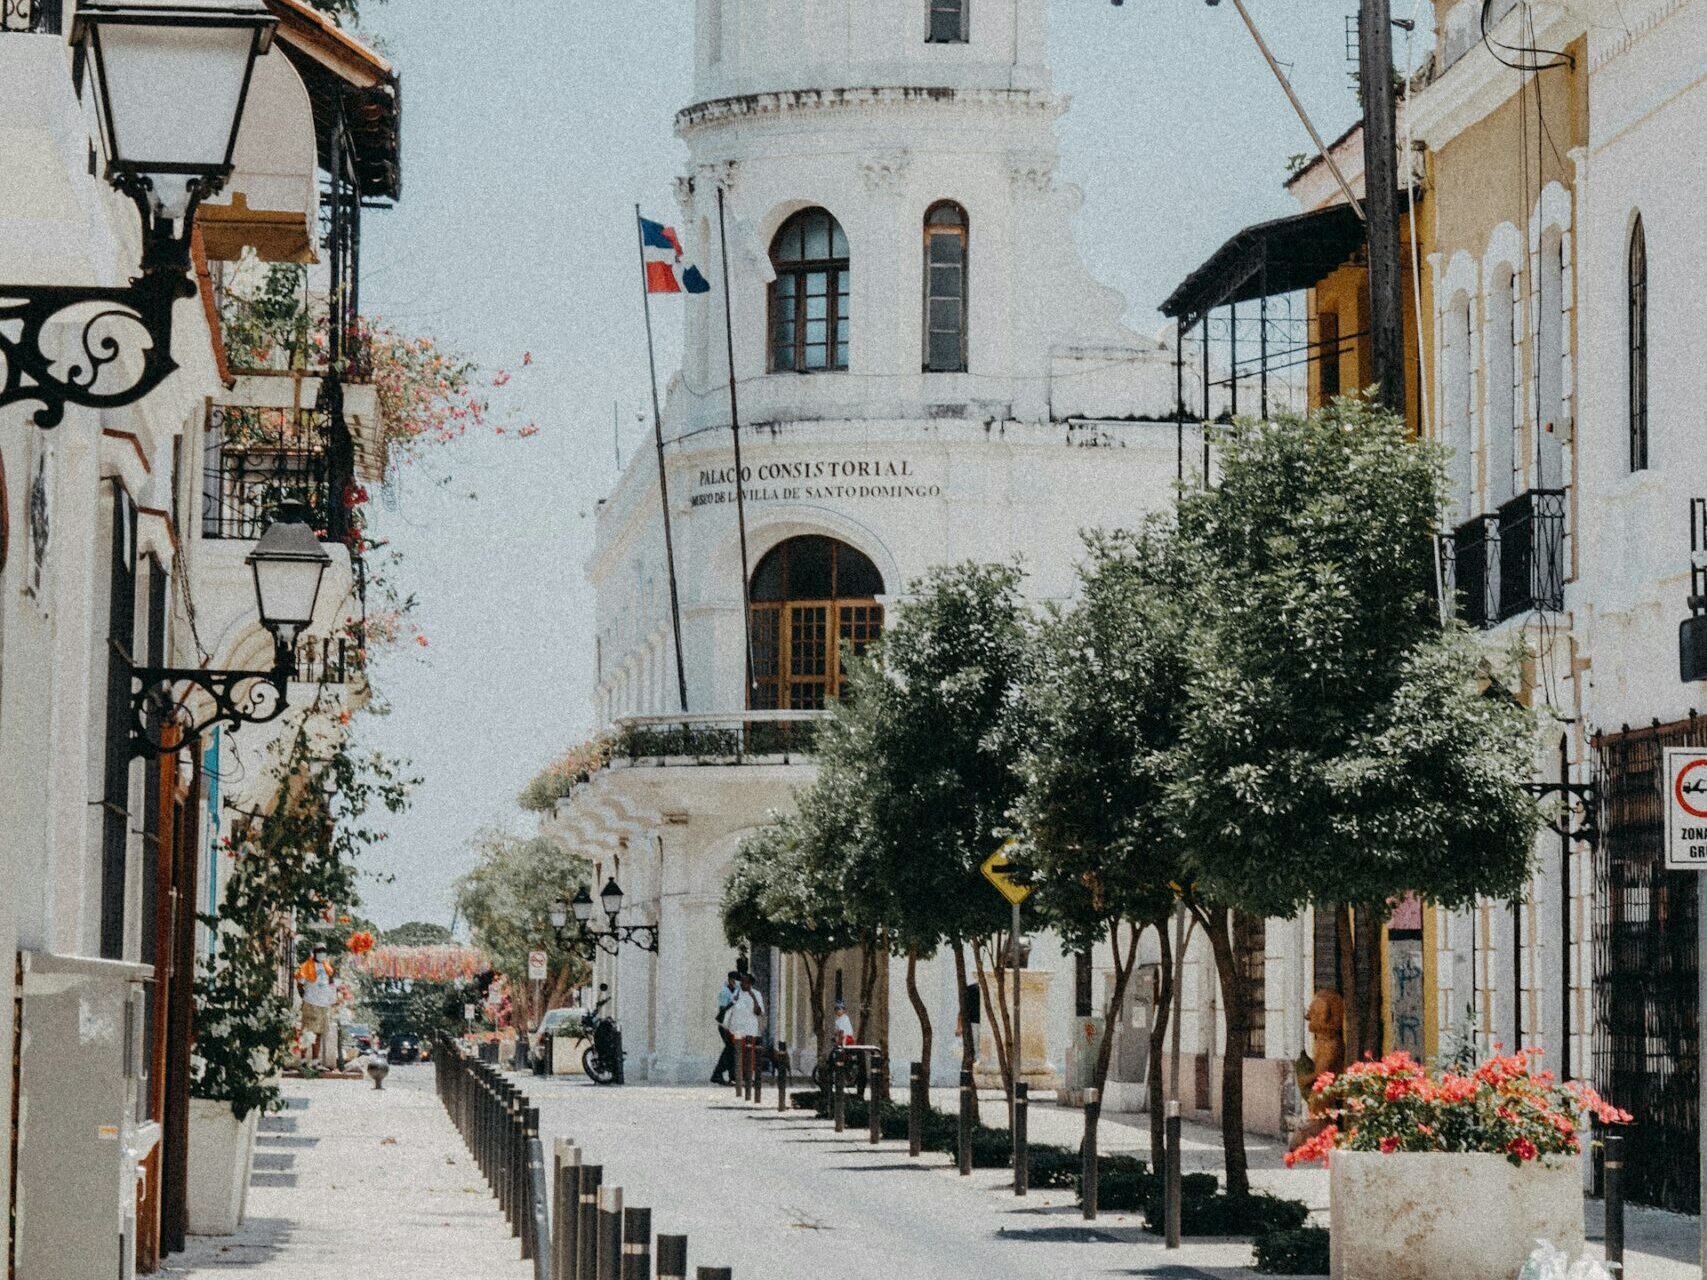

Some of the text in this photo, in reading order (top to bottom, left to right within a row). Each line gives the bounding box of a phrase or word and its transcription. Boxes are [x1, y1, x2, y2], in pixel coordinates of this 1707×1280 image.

[699, 460, 914, 486] PALACO CONSISTORIAL
[714, 491, 726, 504] DE
[741, 487, 779, 501] VILLA
[783, 487, 802, 500] DE
